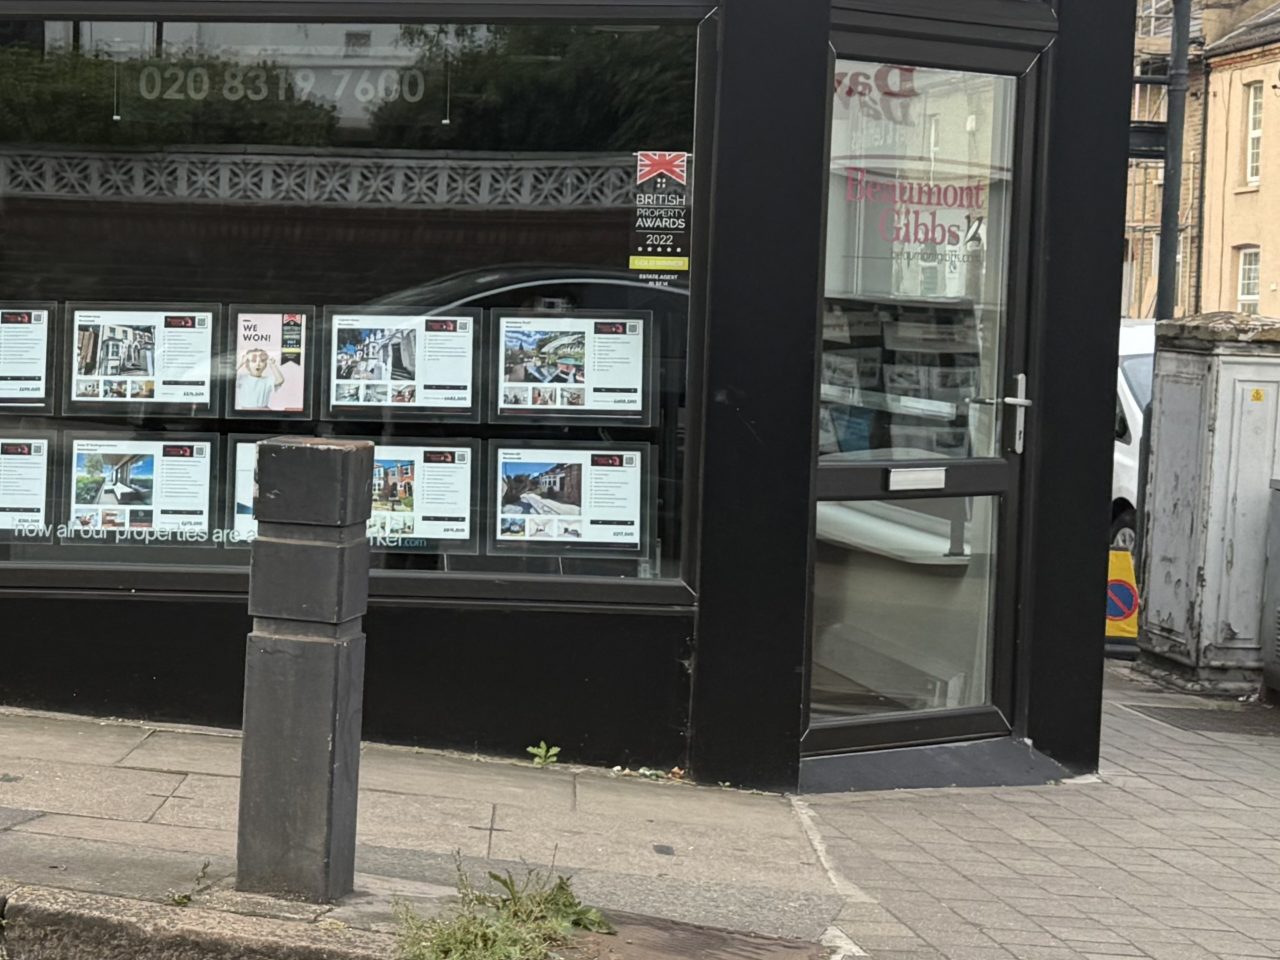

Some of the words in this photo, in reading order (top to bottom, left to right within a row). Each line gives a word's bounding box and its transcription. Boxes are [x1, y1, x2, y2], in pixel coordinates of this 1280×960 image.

[139, 67, 210, 101] 020
[223, 68, 313, 103] 8319
[333, 69, 425, 105] 7600
[846, 166, 985, 209] Beaumont
[636, 193, 686, 206] BRITISH
[636, 208, 687, 218] PROPERTY
[635, 218, 686, 229] AWARDS
[879, 207, 961, 246] Gibbs
[646, 234, 673, 246] 2022
[243, 324, 258, 332] WE
[243, 334, 271, 342] WON!
[14, 523, 53, 538] now
[56, 520, 74, 538] all
[80, 525, 107, 539] our
[115, 522, 208, 544] properties
[213, 528, 240, 543] are
